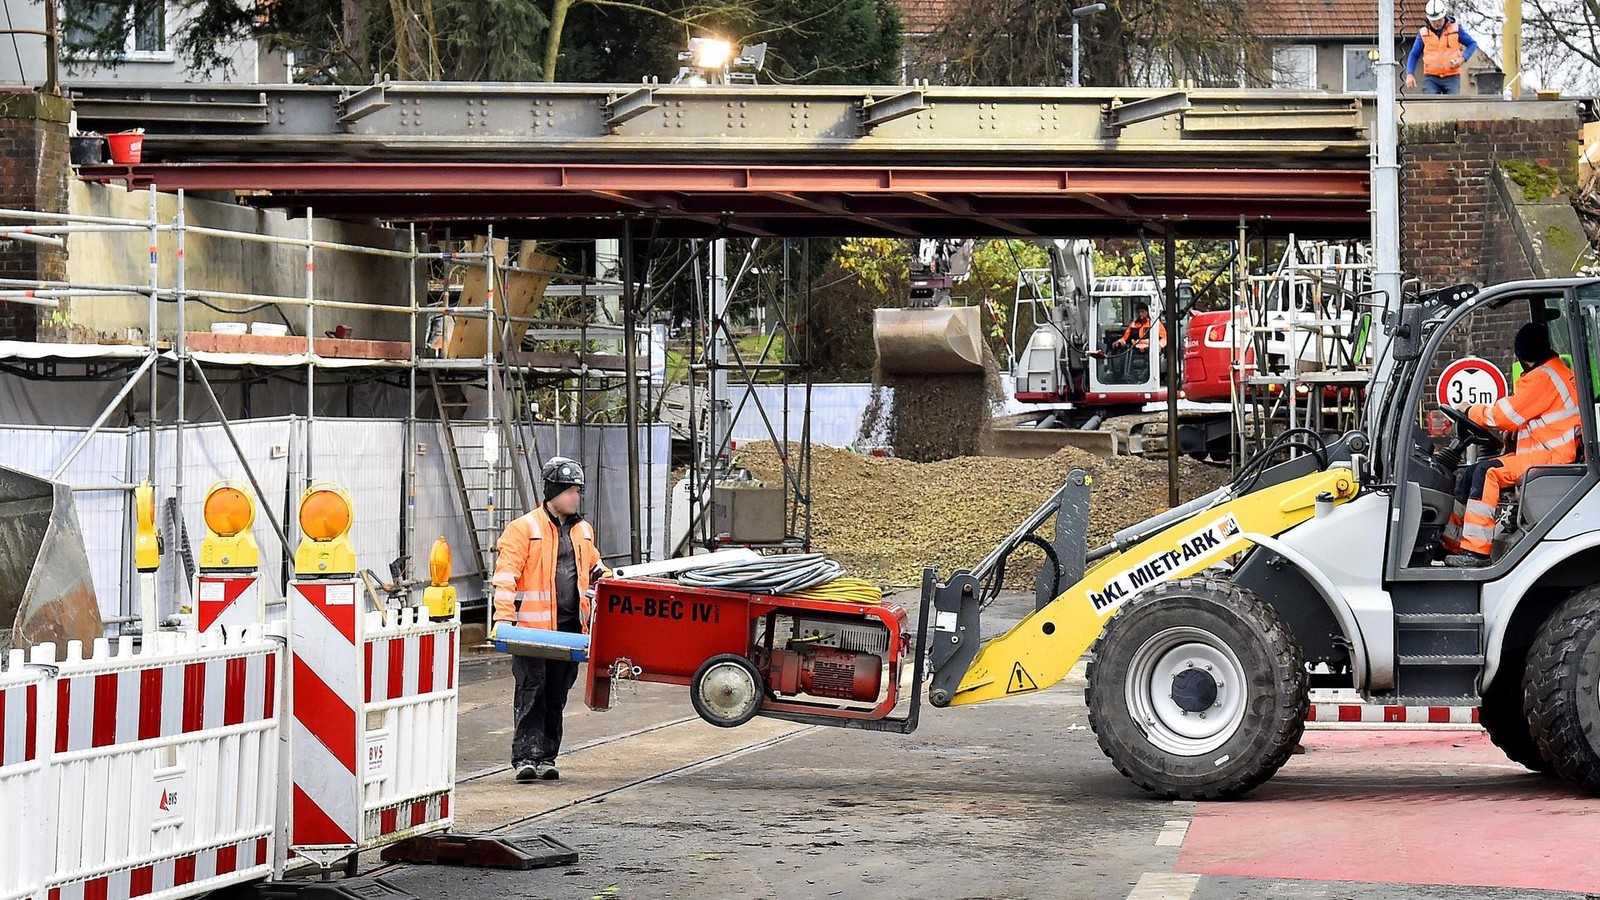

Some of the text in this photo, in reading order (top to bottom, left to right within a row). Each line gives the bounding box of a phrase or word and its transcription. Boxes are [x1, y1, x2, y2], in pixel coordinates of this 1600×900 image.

[1128, 529, 1221, 589] MIETPARK
[608, 594, 684, 621] PA-BEC
[692, 602, 713, 623] IV
